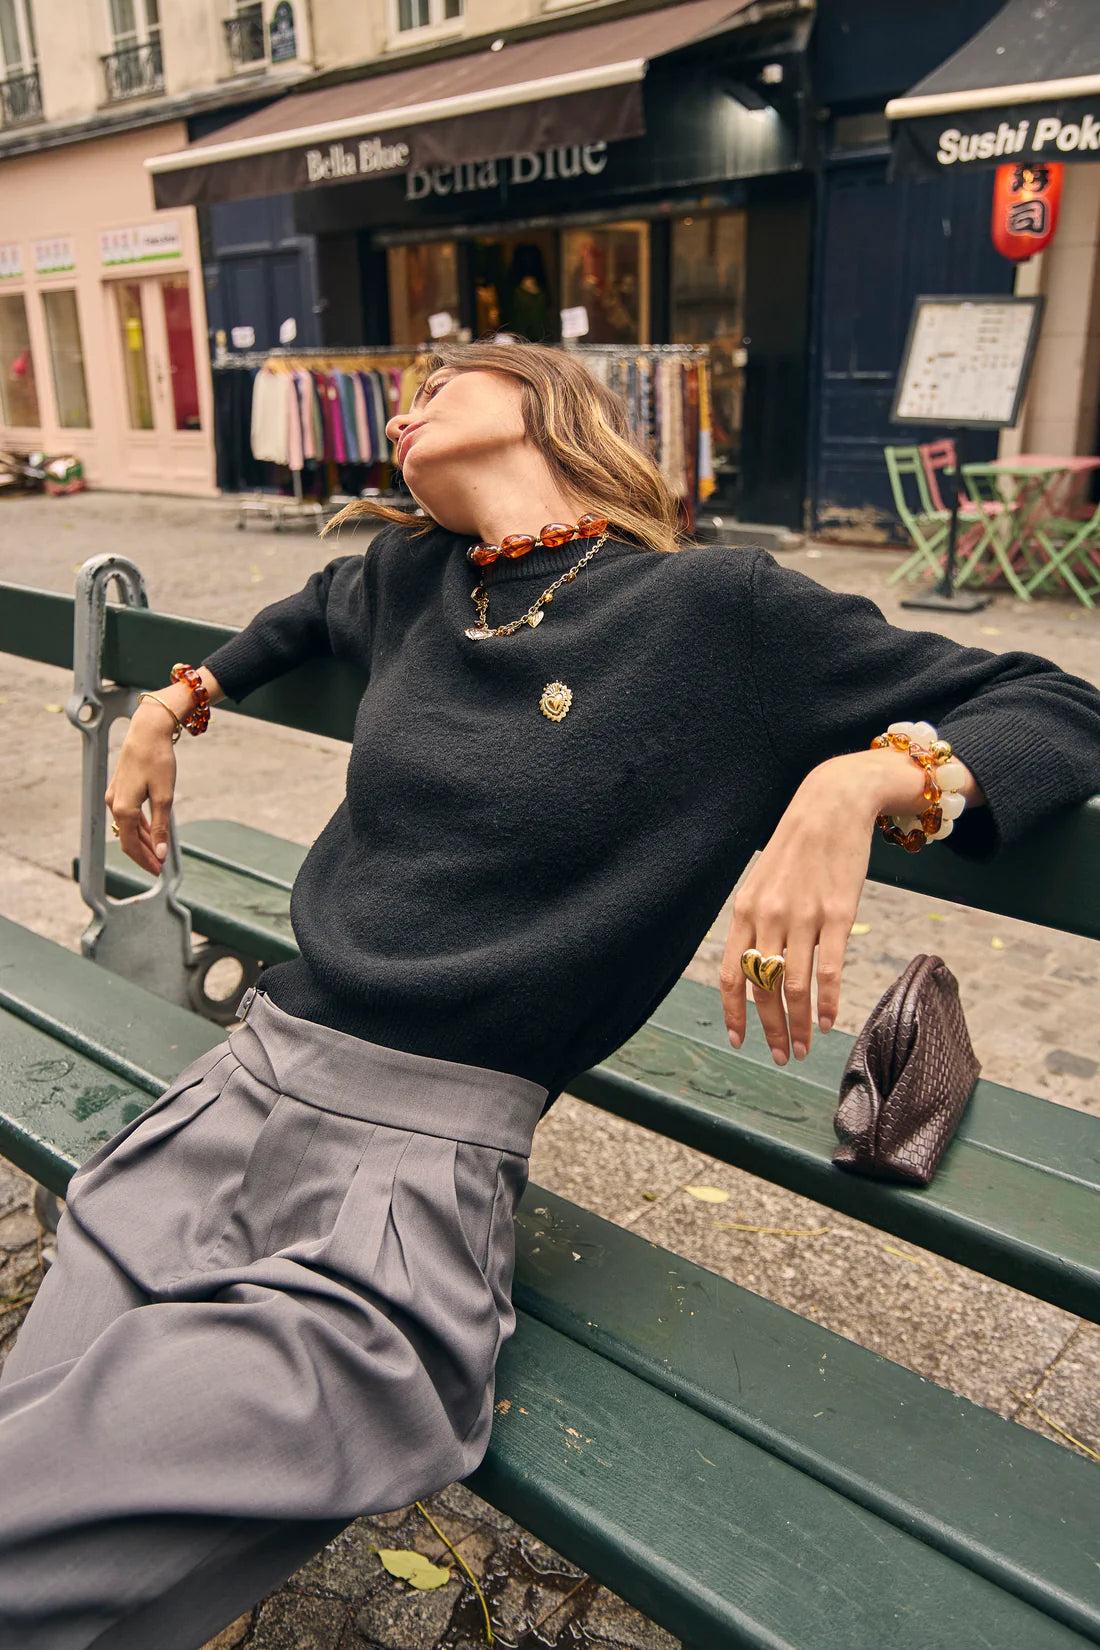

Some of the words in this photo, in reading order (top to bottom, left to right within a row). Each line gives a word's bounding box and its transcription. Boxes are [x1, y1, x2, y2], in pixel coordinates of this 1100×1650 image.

[305, 143, 357, 182] Bella
[358, 136, 410, 173] Blue
[510, 139, 608, 185] Blue
[937, 119, 1030, 165] Sushi
[1031, 114, 1100, 151] Pok
